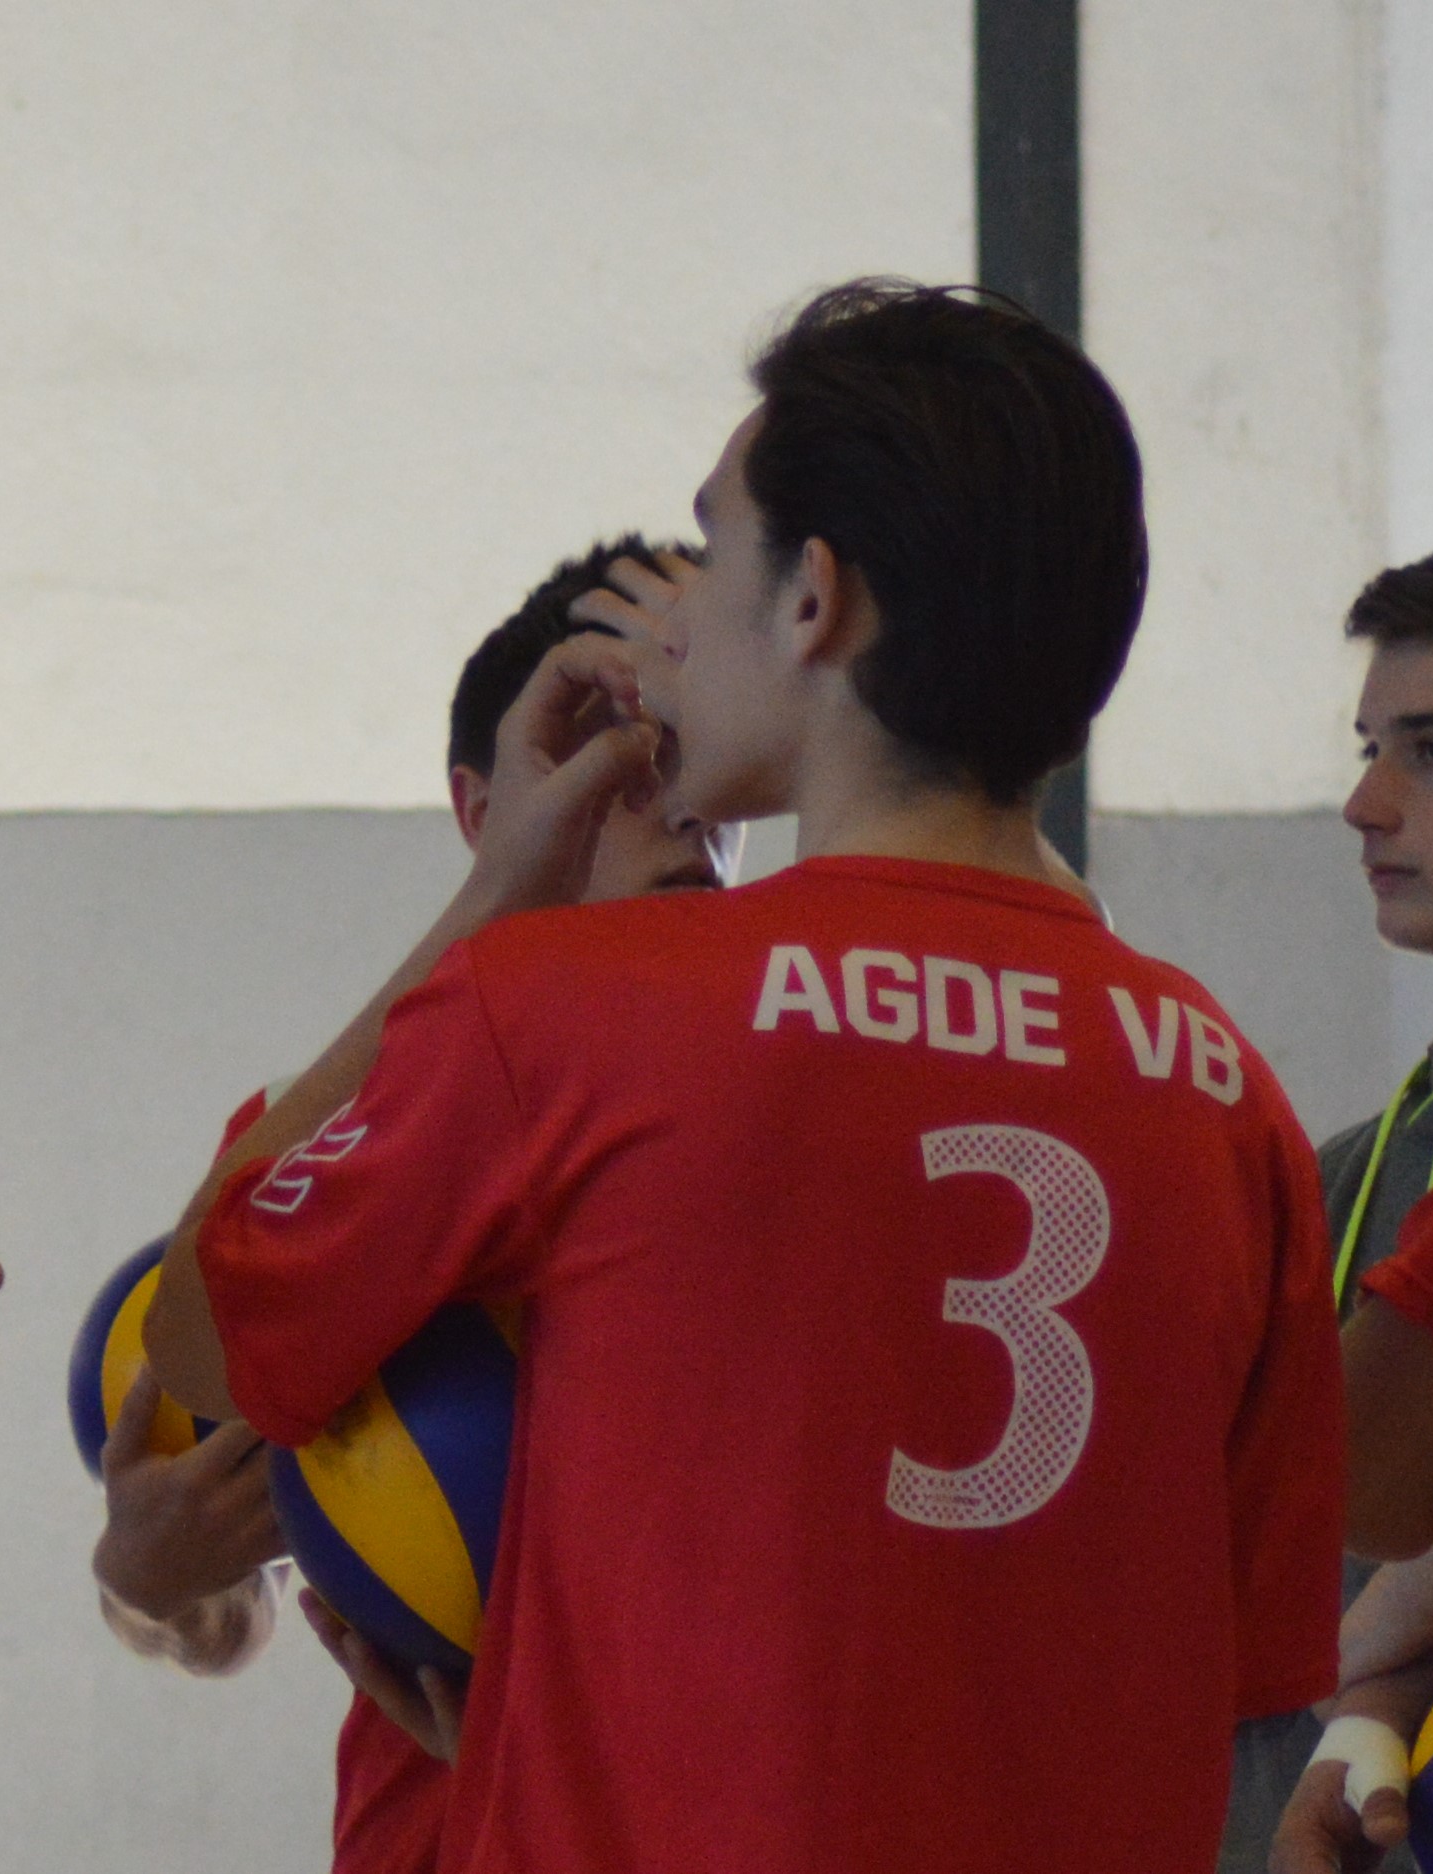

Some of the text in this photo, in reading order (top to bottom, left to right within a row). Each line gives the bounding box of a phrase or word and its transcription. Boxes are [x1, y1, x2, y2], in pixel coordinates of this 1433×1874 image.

[752, 945, 1243, 1107] AGDE VB
[885, 1123, 1111, 1529] 3
